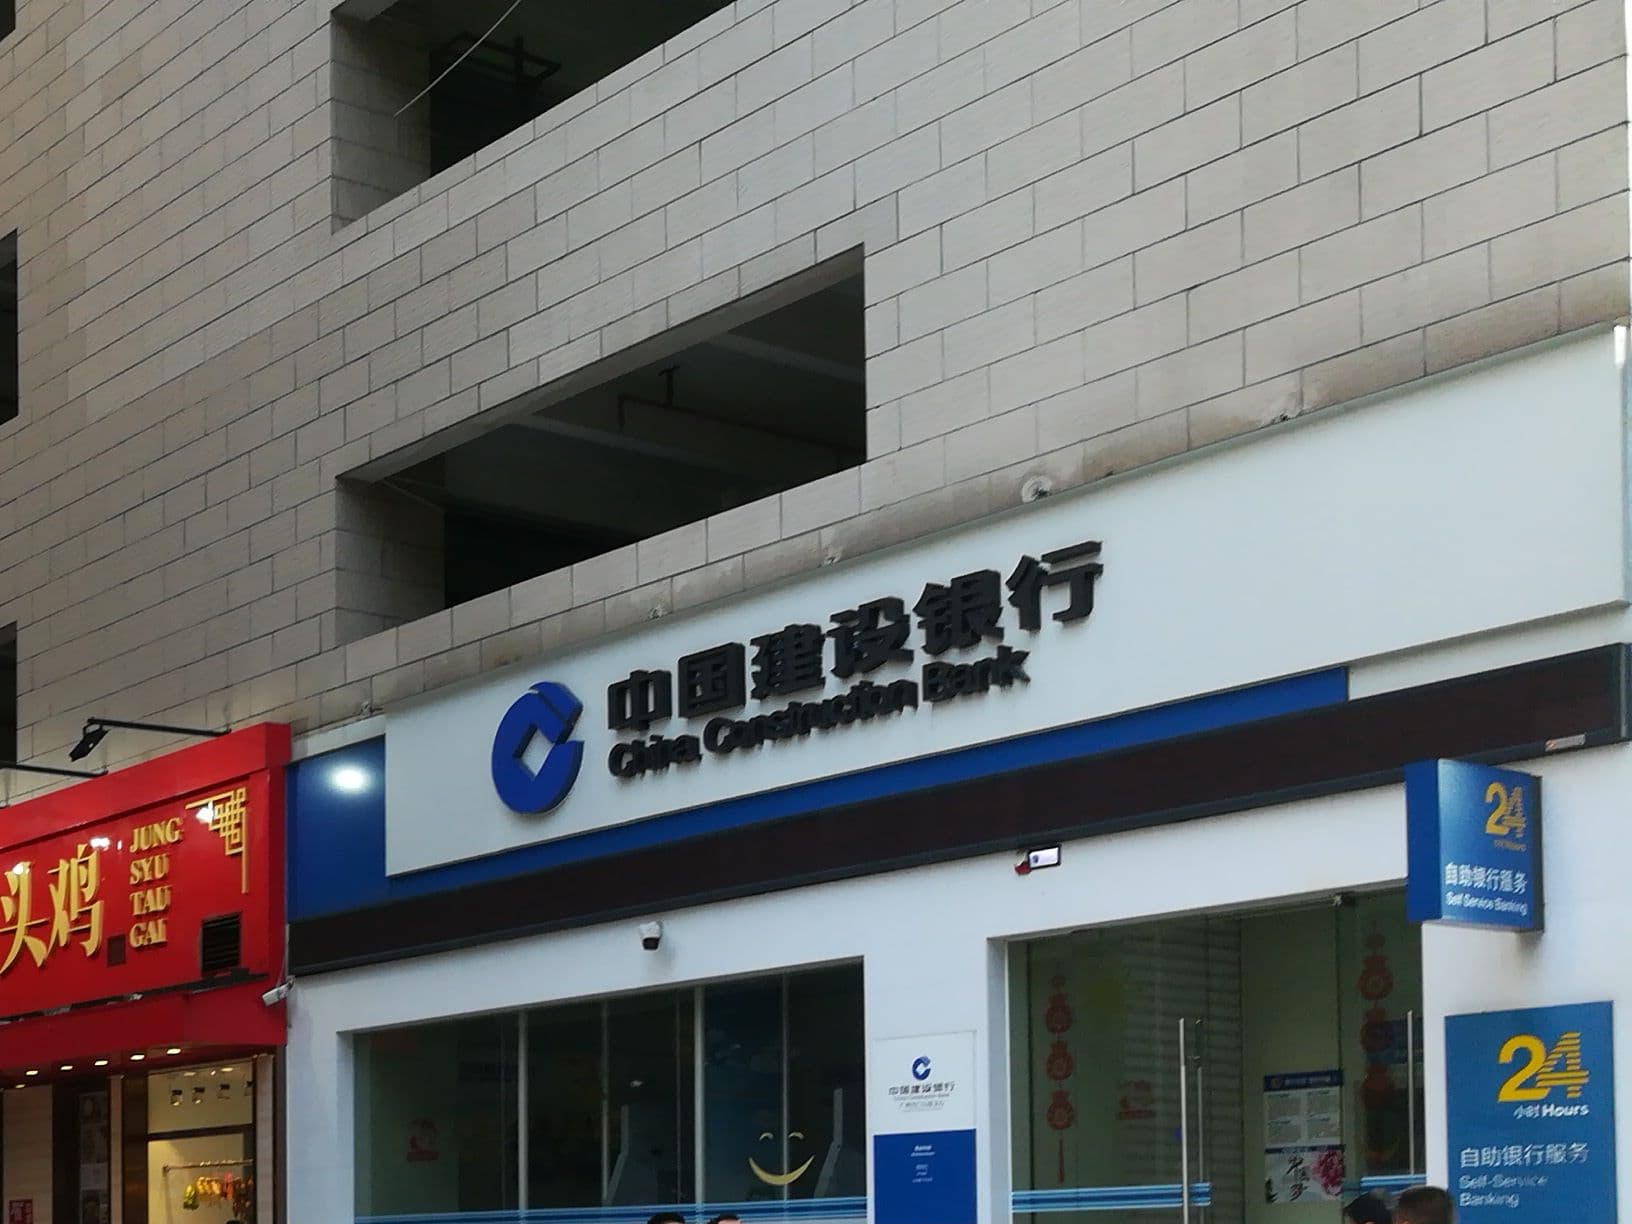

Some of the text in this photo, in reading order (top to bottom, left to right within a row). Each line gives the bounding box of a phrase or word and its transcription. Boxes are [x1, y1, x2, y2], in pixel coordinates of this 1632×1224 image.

[608, 540, 1104, 730] 中国建设银行
[608, 645, 1031, 778] China Construction Bank
[1484, 782, 1527, 839] 24
[130, 816, 184, 853] JUNG
[130, 853, 171, 885] SYU
[1444, 861, 1528, 894] 自助银行服务
[129, 885, 173, 916] TAU
[130, 918, 168, 948] GAI
[1497, 1031, 1589, 1103] 24
[1542, 1104, 1589, 1117] Hours
[1460, 1143, 1588, 1168] 自助银行服务
[1459, 1192, 1519, 1209] Banking
